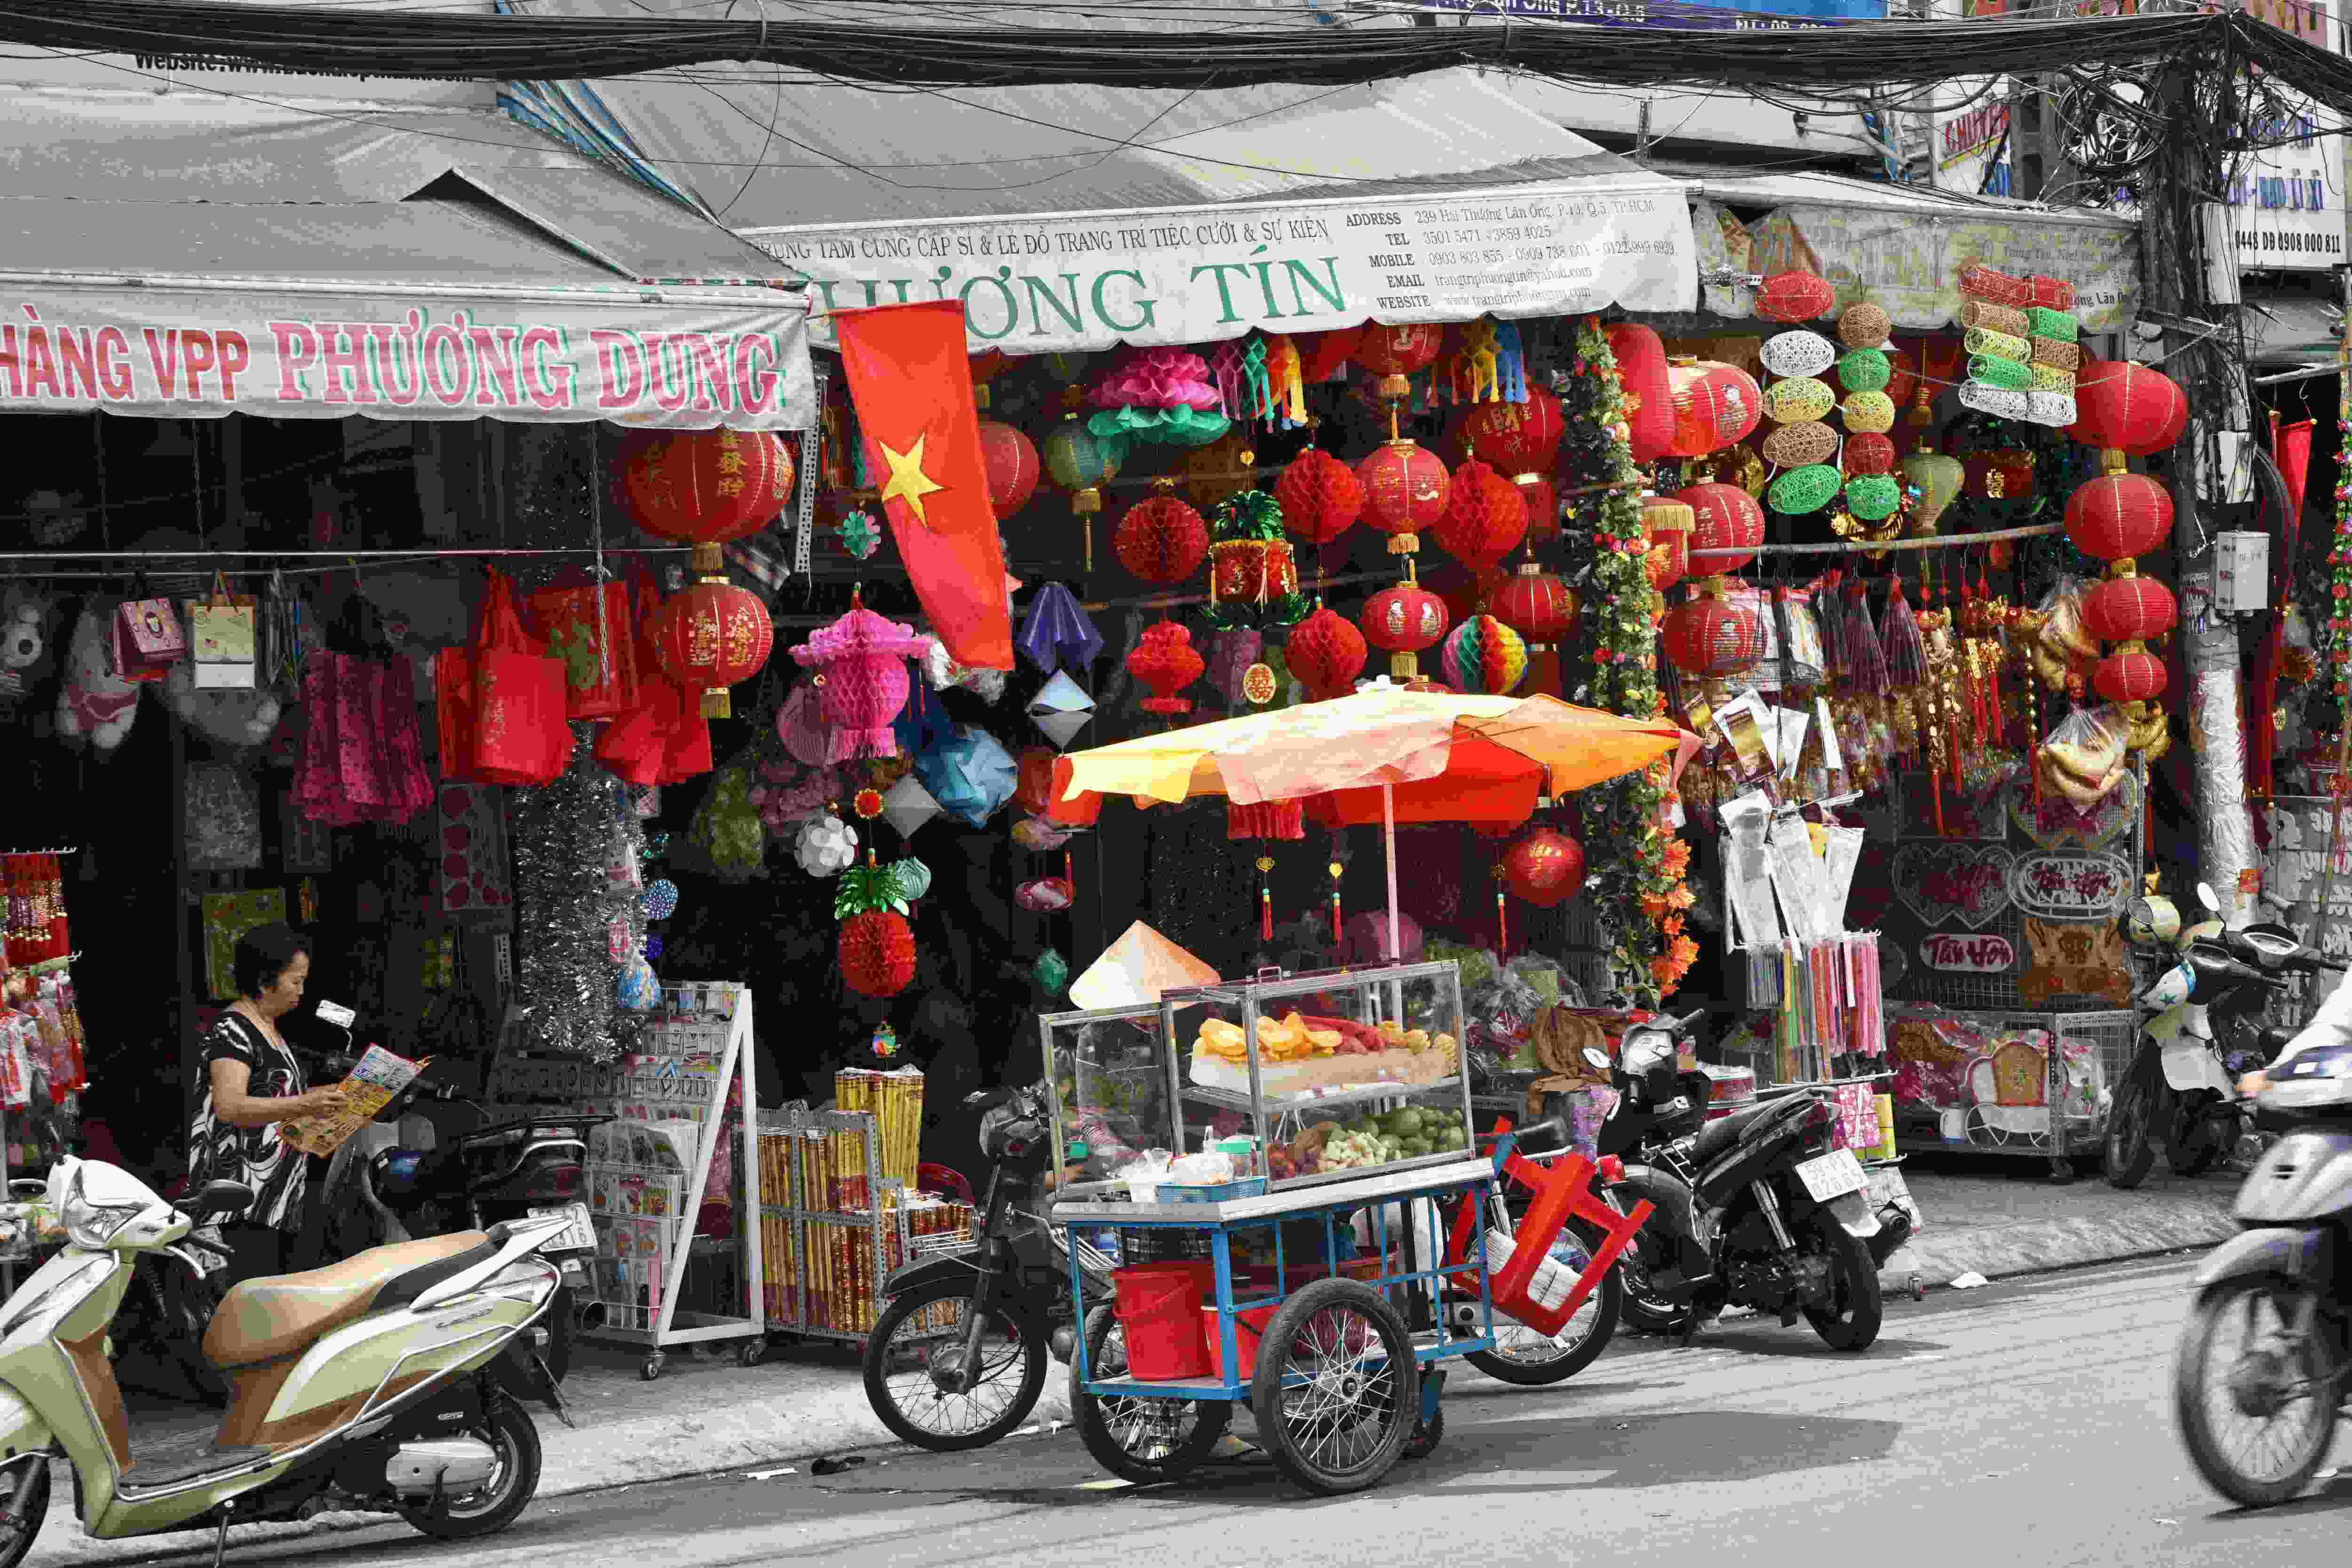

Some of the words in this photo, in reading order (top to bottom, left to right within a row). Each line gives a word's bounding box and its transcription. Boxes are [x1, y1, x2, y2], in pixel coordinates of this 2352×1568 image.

[1346, 212, 1401, 226] ADDRESS
[1415, 210, 1437, 224] 239
[861, 237, 911, 259] CUNG
[981, 235, 993, 256] &
[1023, 225, 1049, 253] ĐỒ
[1054, 230, 1113, 252] TRANG
[1117, 223, 1147, 249] TRÍ
[1150, 222, 1192, 251] TIỆC
[1196, 218, 1239, 245] CƯỚI
[1243, 222, 1257, 243] &
[1260, 218, 1283, 245] SỰ
[1287, 215, 1329, 244] KIỆN
[1385, 232, 1410, 245] TEL
[1524, 225, 1551, 239] 4025
[2304, 233, 2322, 252] 000
[2325, 233, 2341, 253] 811
[1368, 253, 1415, 268] MOBILE
[1190, 244, 1347, 324] TÍN
[1386, 274, 1426, 288] EMAIL
[1376, 294, 1431, 309] WEBSITE
[142, 327, 250, 403] VPP
[267, 308, 579, 410] PHƯƠNG
[589, 328, 787, 415] DUNG
